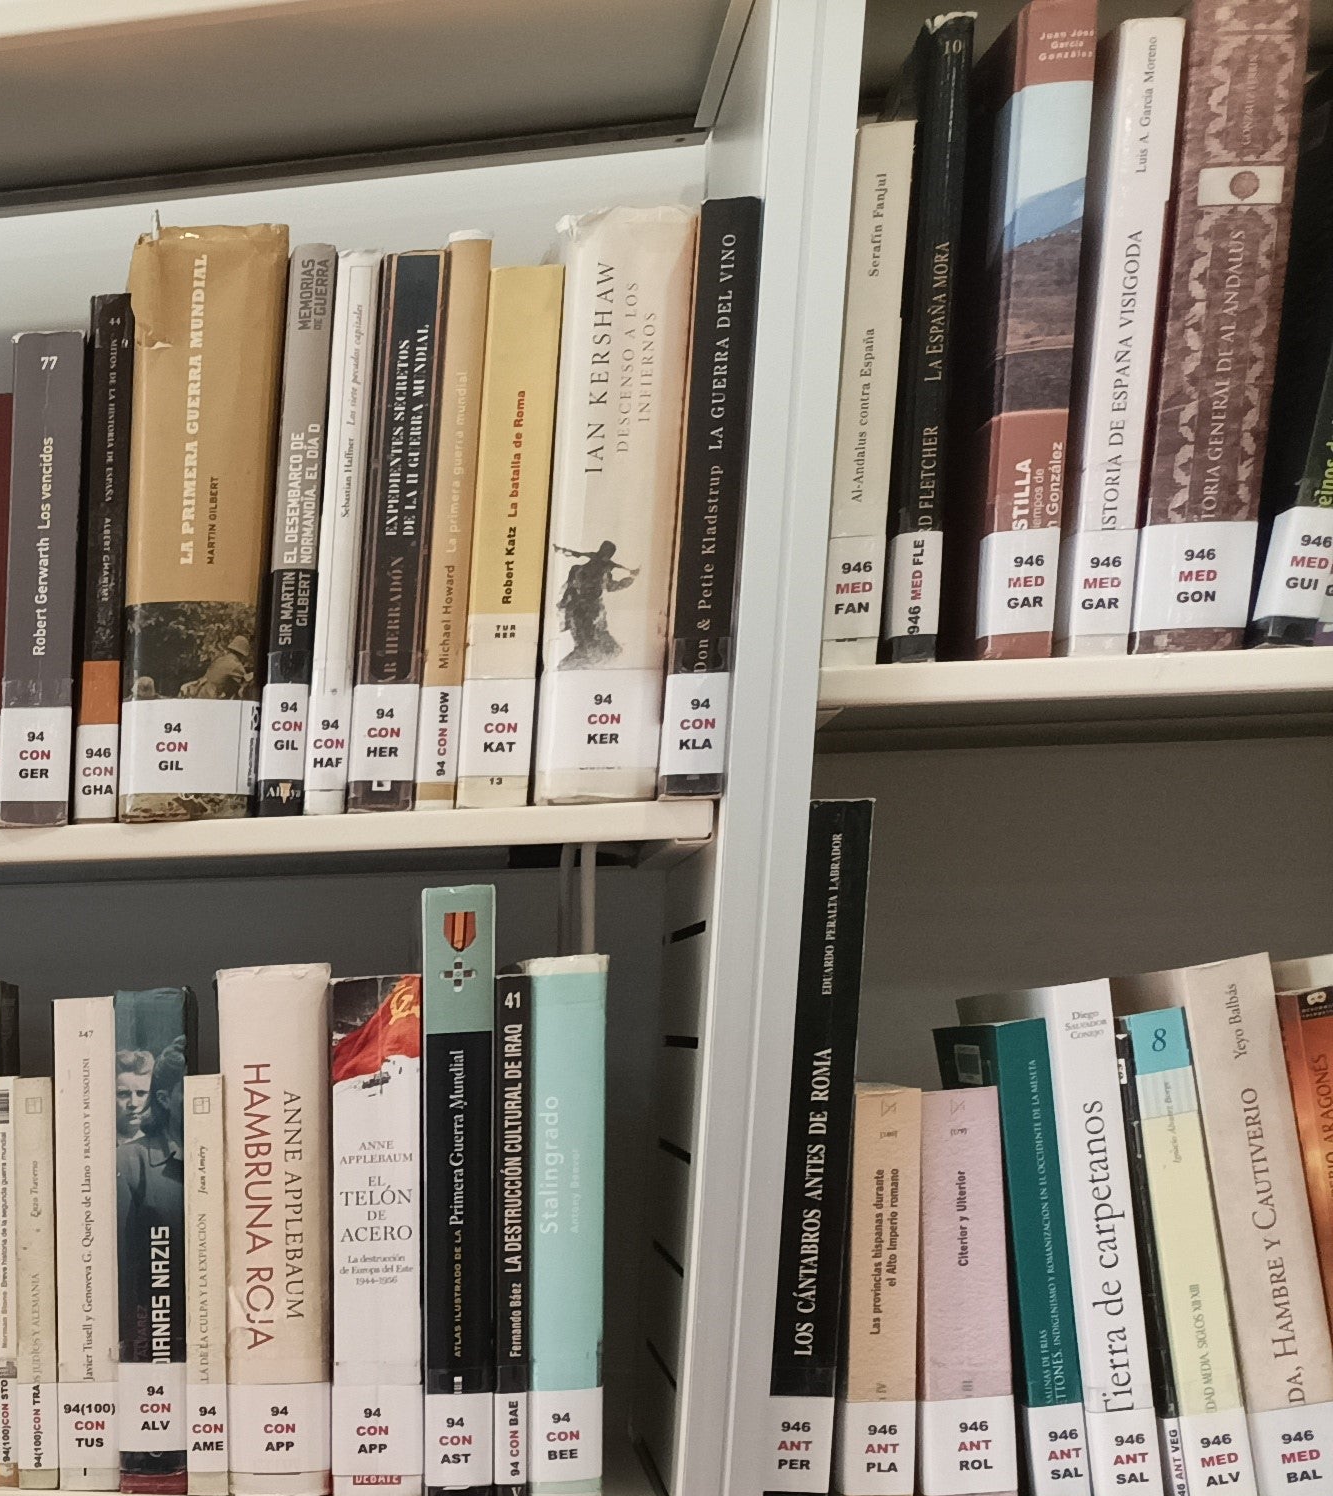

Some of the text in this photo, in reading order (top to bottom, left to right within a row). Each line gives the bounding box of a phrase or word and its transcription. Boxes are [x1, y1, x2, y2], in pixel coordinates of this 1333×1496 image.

[181, 255, 207, 565] LA PRIMERA GUERRA MUNDIAL
[585, 262, 615, 474] IAN KERSHAW
[709, 234, 737, 450] LA GUERRA DEL VINO
[33, 437, 53, 656] Robert Gerwarth Los vencidos
[834, 601, 869, 614] FAN
[836, 581, 873, 594] MED
[841, 561, 872, 574] 946
[244, 1064, 273, 1255] HAMBRUNA
[283, 1090, 304, 1319] ANNE APPLEBAUM
[792, 1048, 832, 1357] LOS CÁNTABROS ANTES DE ROMA
